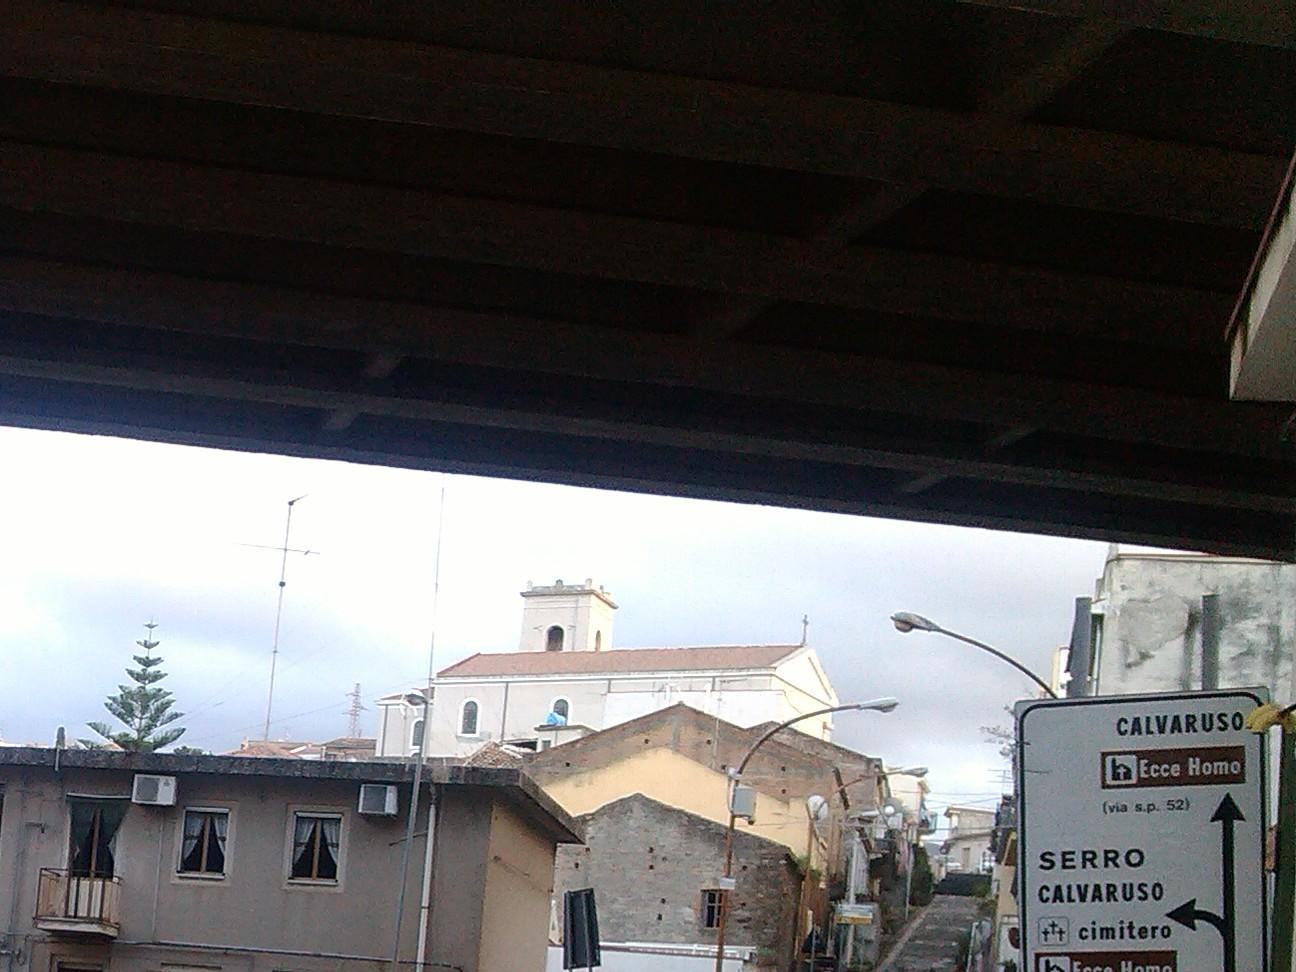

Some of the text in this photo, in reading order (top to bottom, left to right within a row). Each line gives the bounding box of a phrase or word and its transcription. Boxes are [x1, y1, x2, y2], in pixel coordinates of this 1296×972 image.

[1116, 711, 1245, 737] CALVARUSO
[1139, 756, 1241, 778] Ecce Homo
[1102, 800, 1129, 815] (via
[1038, 849, 1145, 871] SERRO
[1038, 882, 1164, 904] CALVARUSO
[1078, 920, 1172, 941] cimitero
